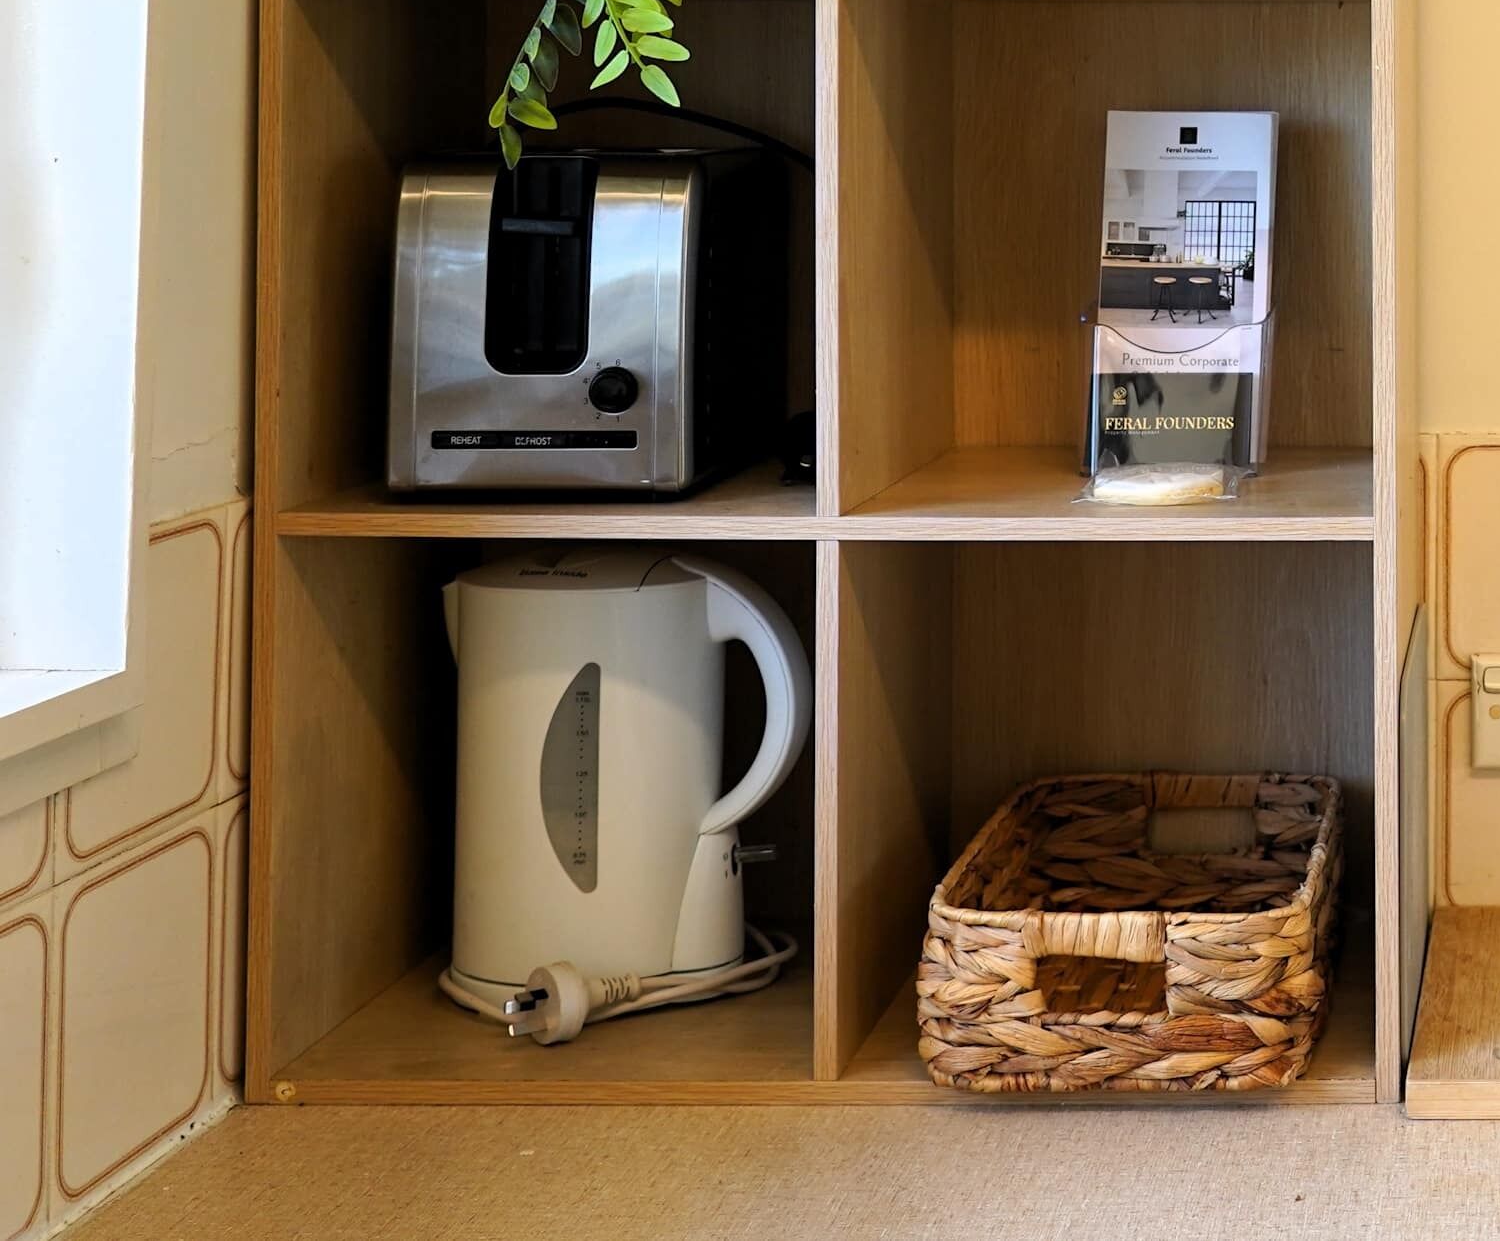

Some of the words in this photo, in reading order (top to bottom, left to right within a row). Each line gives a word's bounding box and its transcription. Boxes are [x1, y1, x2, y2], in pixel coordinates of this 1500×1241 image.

[1122, 352, 1174, 366] Premium
[1179, 354, 1240, 369] Corporate
[1105, 417, 1152, 430] FERAL
[1155, 416, 1235, 430] FOUNDERS
[450, 436, 482, 445] REHEAT
